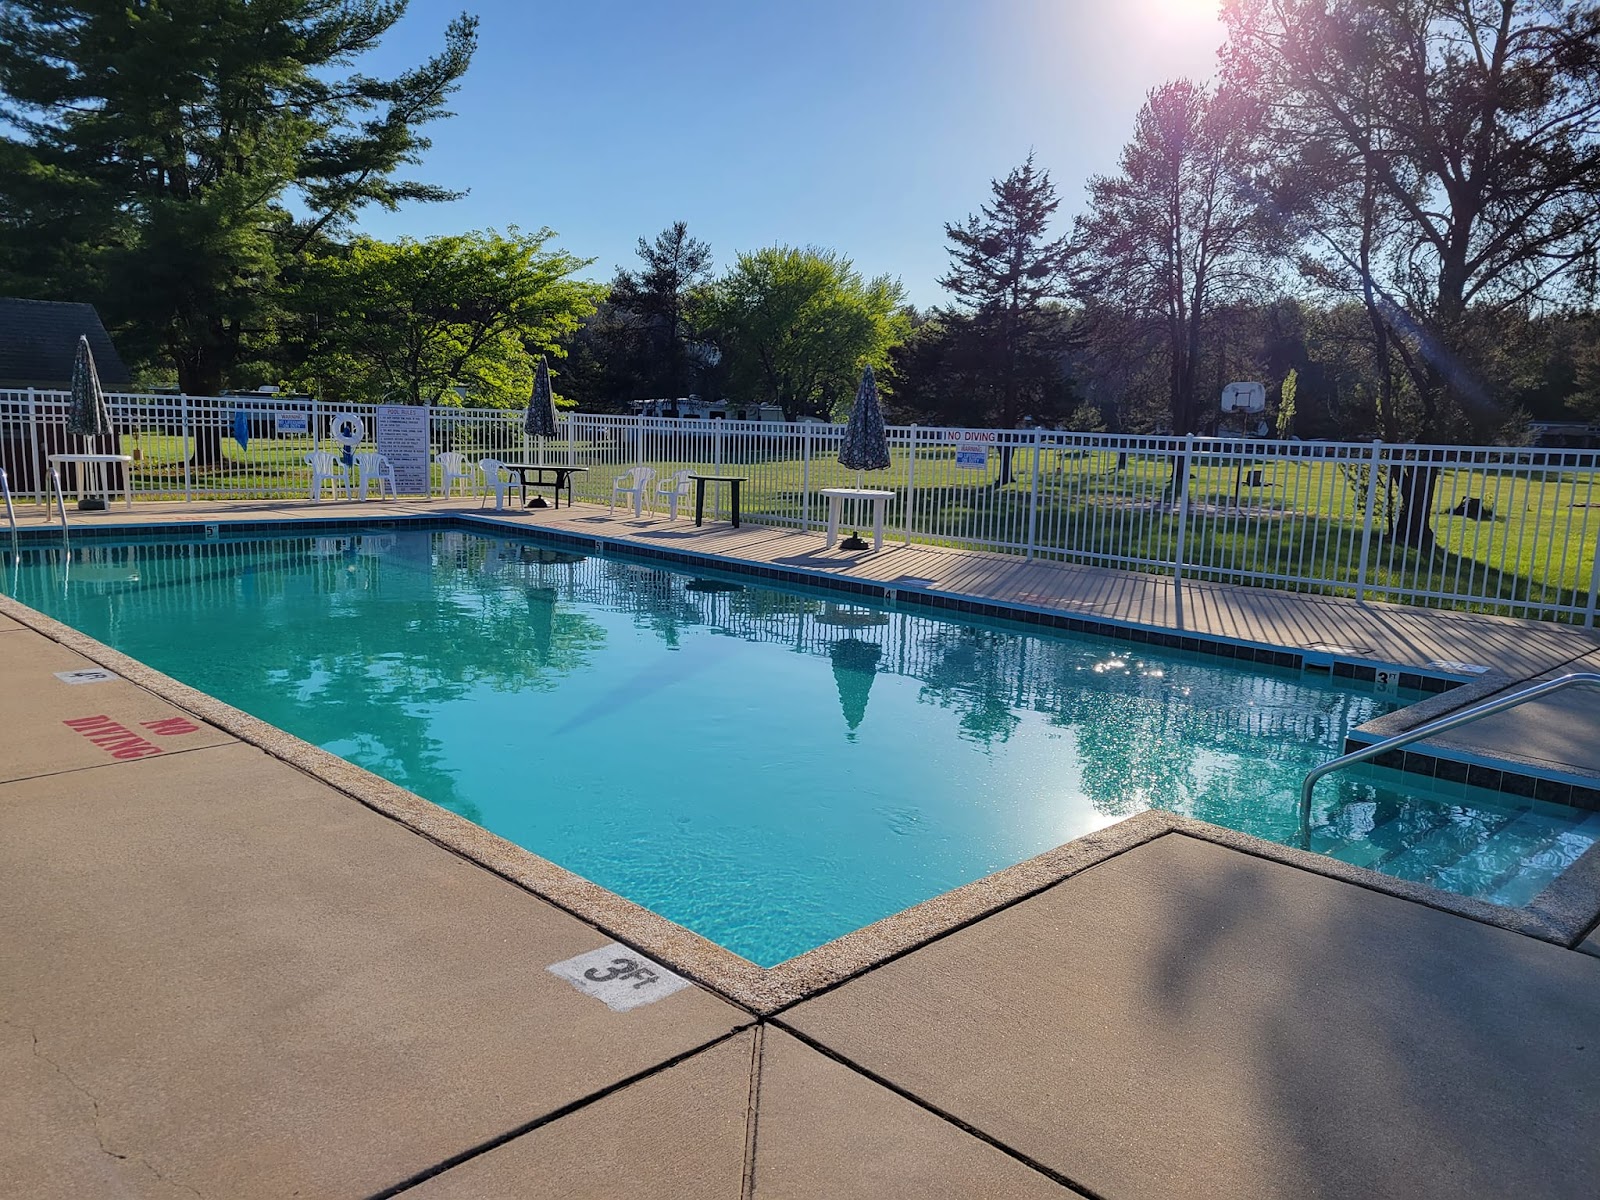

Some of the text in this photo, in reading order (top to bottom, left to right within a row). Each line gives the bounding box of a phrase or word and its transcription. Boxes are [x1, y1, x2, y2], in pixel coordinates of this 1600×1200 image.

[948, 431, 995, 441] NO DIVING
[139, 716, 200, 736] NO
[62, 714, 166, 759] DIVING
